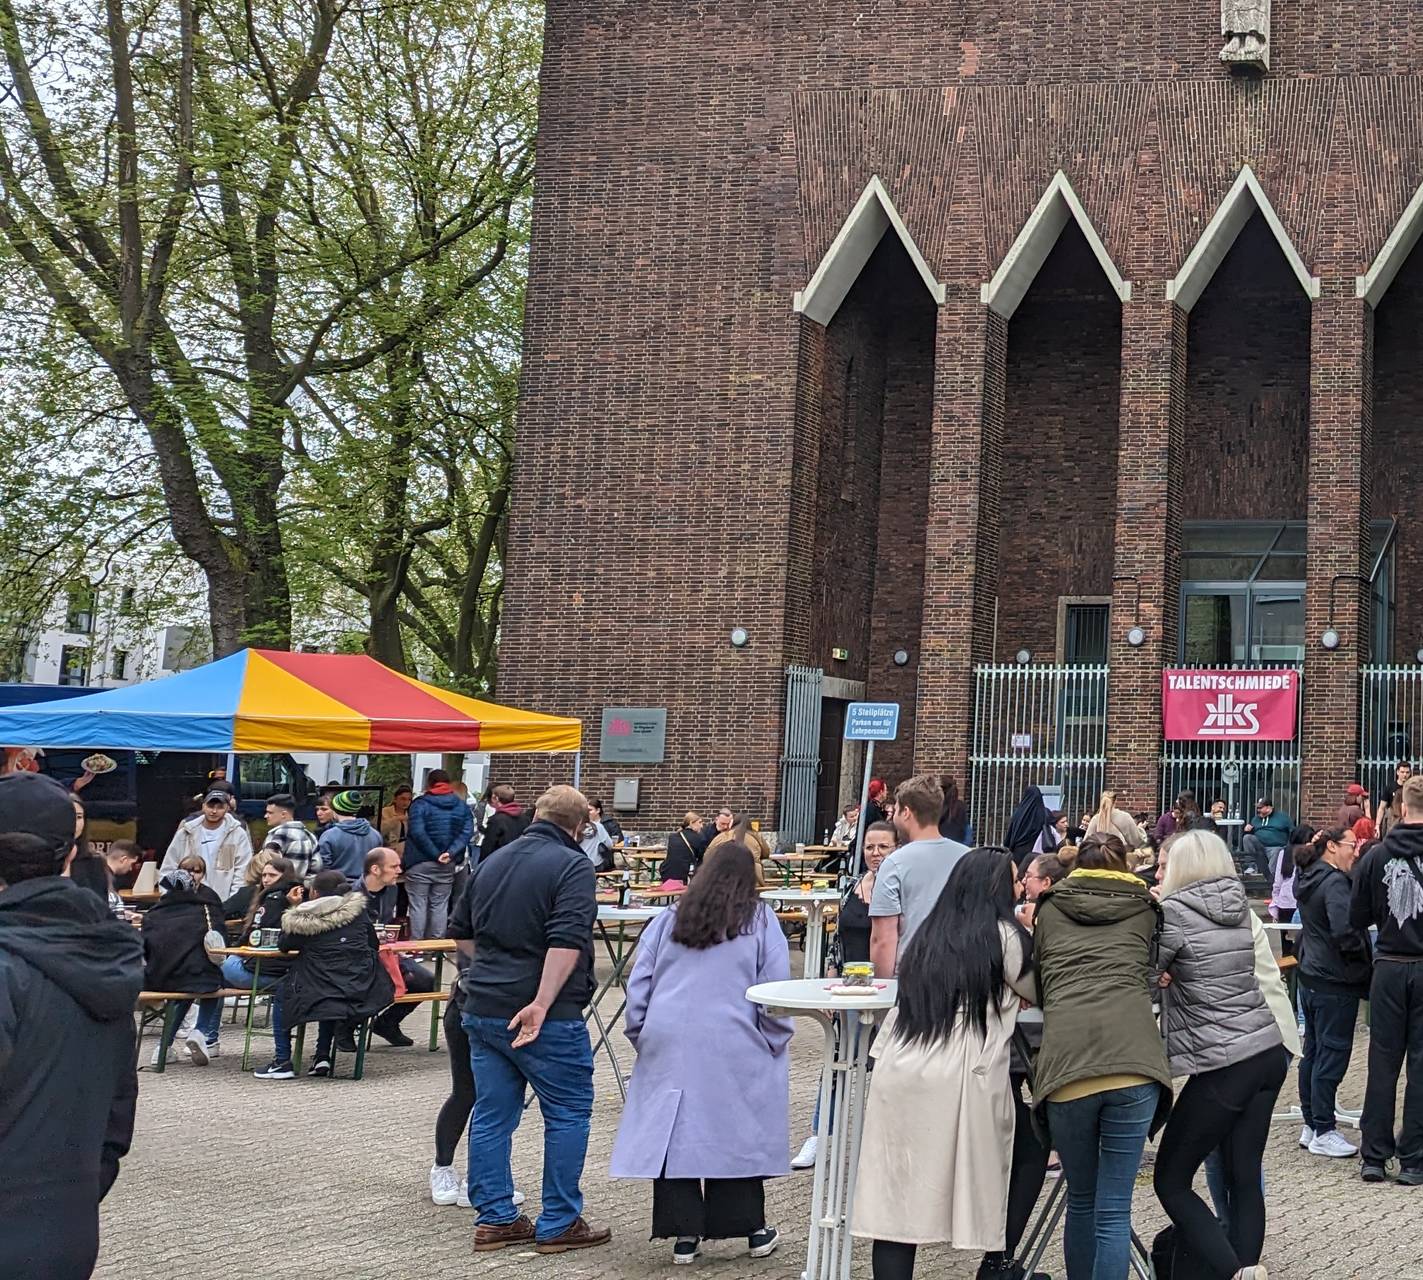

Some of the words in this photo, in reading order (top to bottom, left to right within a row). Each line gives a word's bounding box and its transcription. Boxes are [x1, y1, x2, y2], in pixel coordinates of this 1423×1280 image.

[1168, 675, 1290, 690] TALENTSCHMIEDE
[852, 708, 857, 716] 5
[858, 707, 894, 717] Stellplätze
[851, 718, 872, 726] Parken
[883, 718, 892, 726] für
